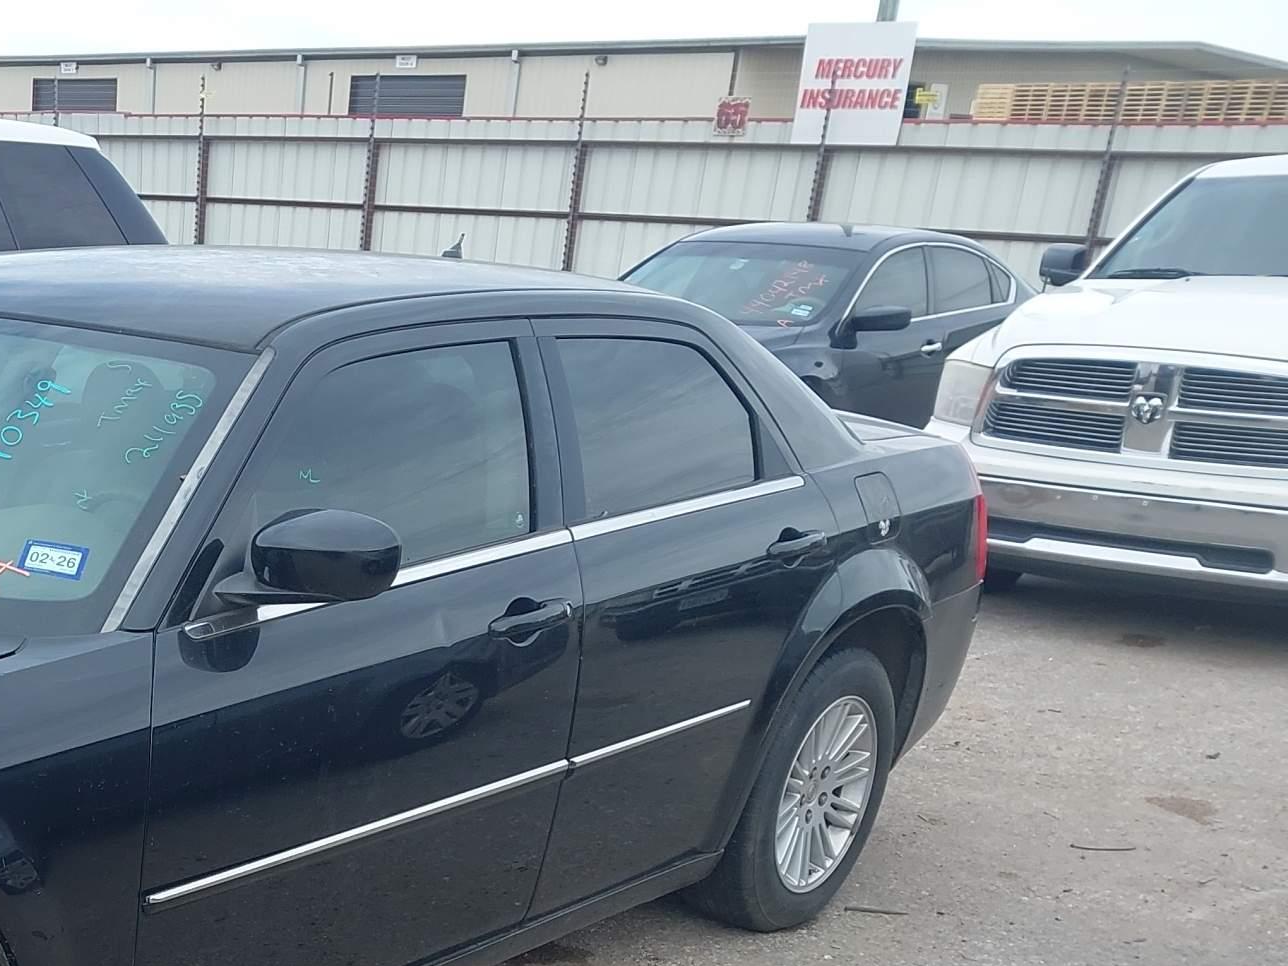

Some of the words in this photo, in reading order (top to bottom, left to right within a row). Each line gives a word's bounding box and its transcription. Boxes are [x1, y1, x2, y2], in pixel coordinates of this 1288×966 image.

[815, 58, 904, 80] MERCURY
[800, 89, 903, 110] INSURANCE
[29, 551, 50, 564] 02
[55, 555, 77, 569] 26
